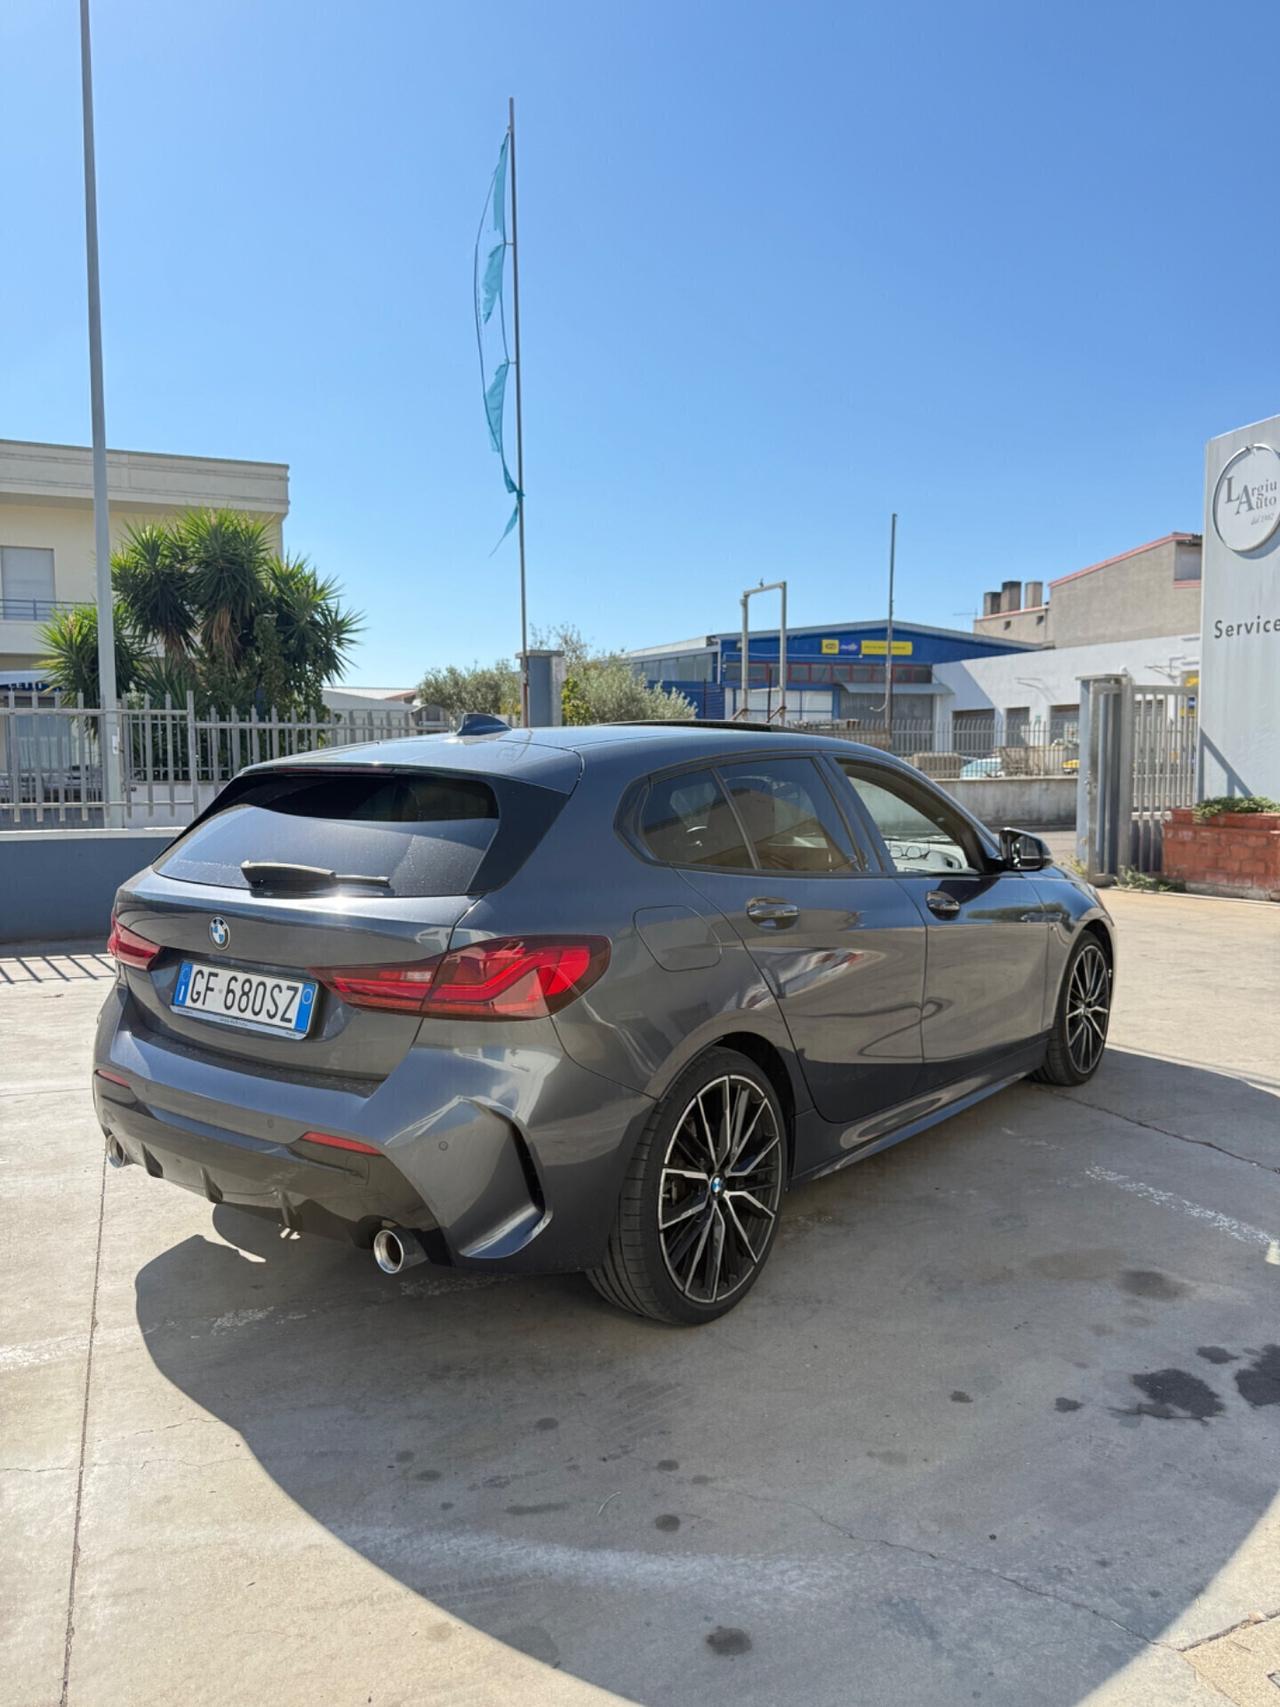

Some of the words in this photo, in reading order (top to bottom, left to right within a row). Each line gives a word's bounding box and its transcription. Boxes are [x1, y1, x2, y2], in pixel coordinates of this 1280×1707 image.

[1225, 476, 1277, 505] Largiu
[1235, 484, 1277, 516] Auto
[1214, 615, 1280, 639] Service
[190, 969, 219, 1006] GF
[223, 975, 300, 1024] 680SZ
